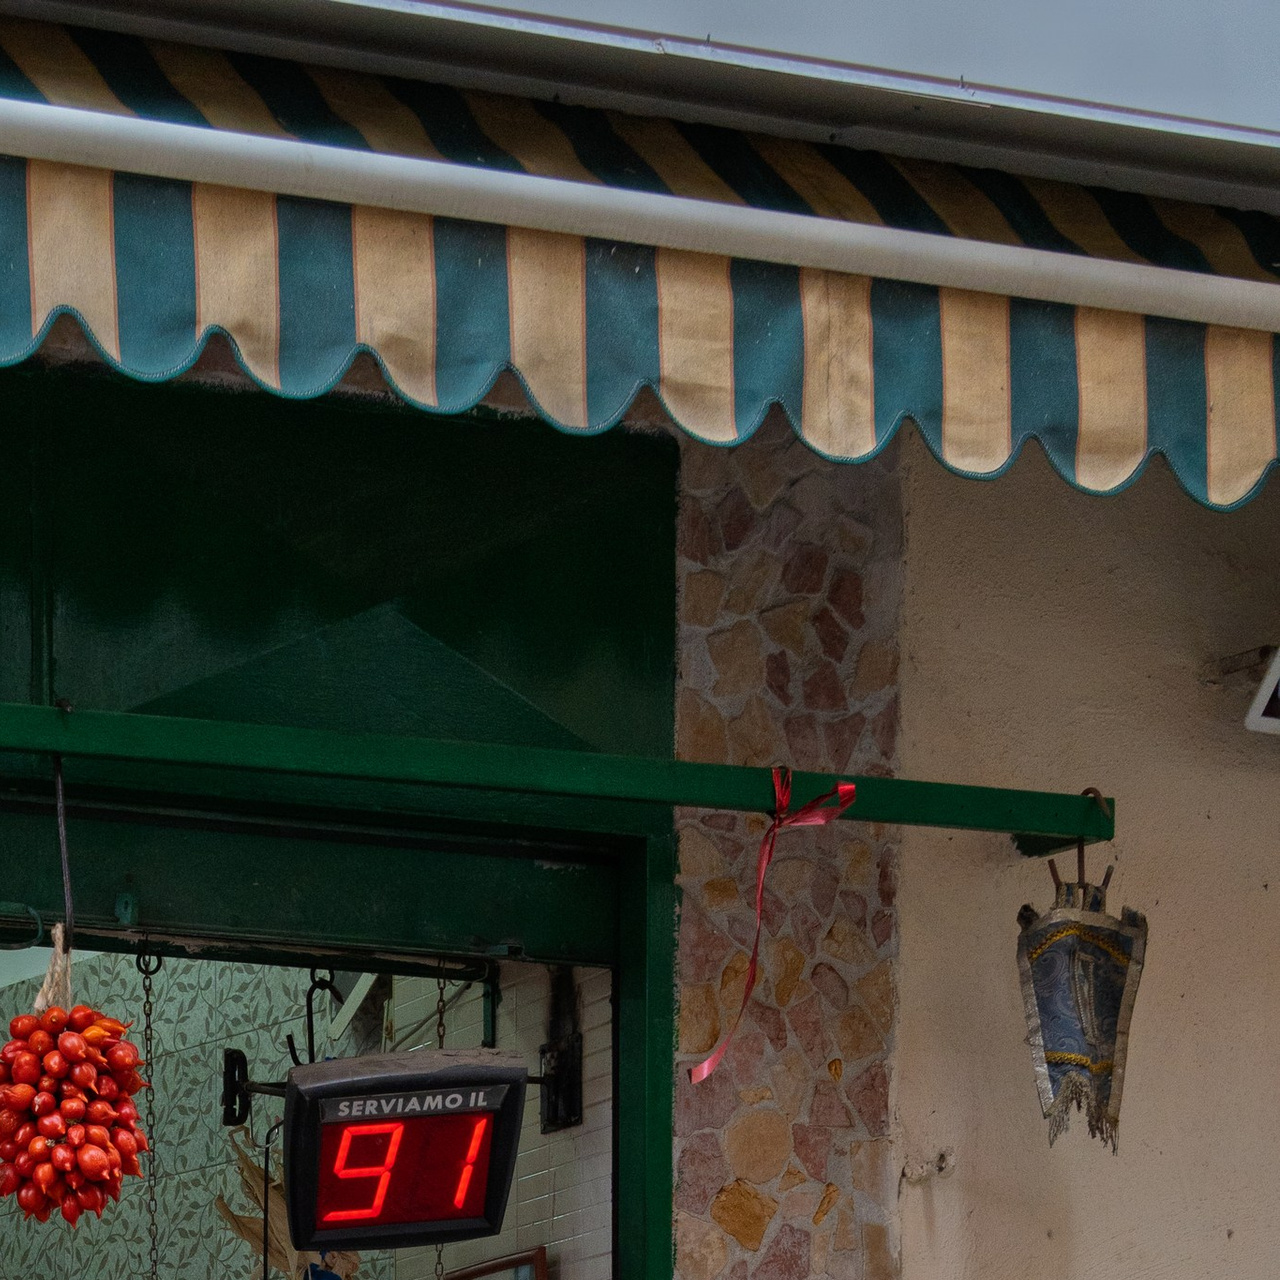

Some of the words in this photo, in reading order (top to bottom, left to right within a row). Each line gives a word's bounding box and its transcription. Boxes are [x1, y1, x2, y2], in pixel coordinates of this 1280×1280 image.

[338, 1093, 463, 1117] SERVIAMO
[468, 1091, 488, 1108] IL
[322, 1118, 488, 1222] 91
